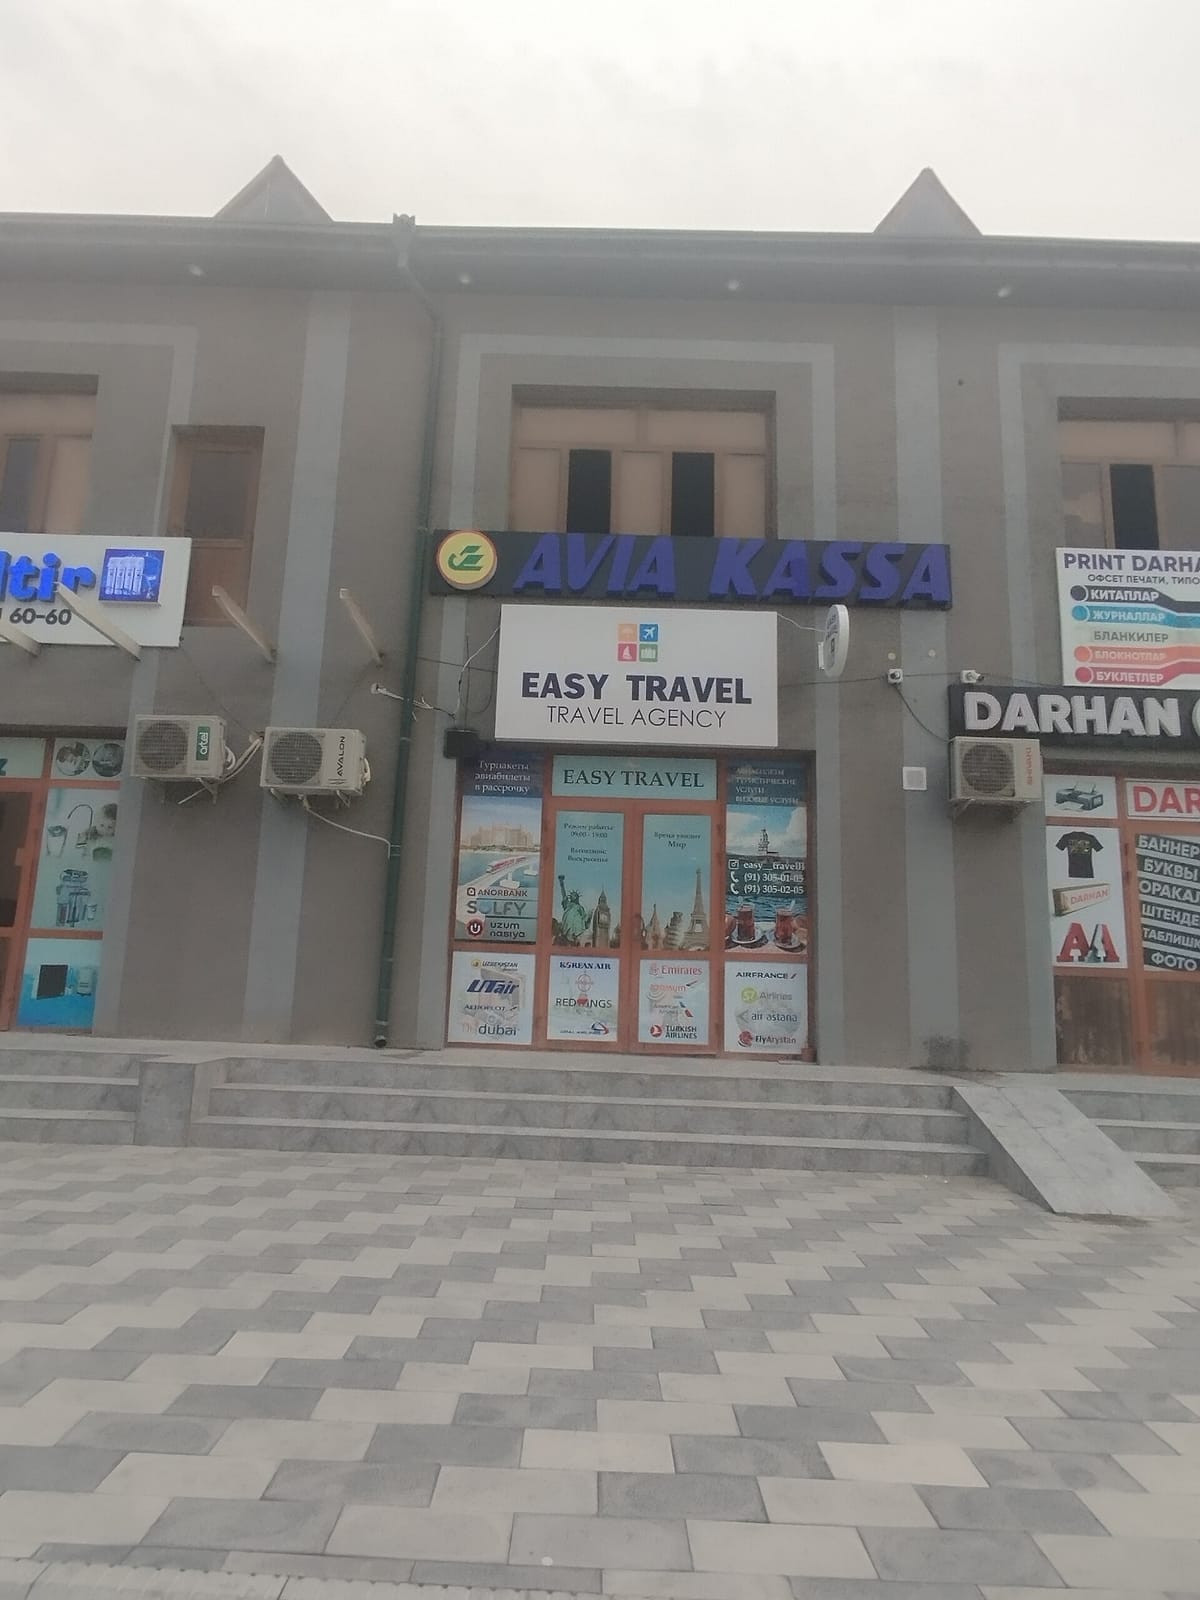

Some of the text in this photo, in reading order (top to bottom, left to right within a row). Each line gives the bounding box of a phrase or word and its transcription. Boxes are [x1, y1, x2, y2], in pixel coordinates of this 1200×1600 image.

[1063, 553, 1125, 570] PRINT
[512, 533, 950, 603] AVIA KASSA
[1088, 574, 1123, 583] ОФСЕТ
[1090, 589, 1160, 602] КИТАПЛАР
[1093, 610, 1165, 621] ЖУРНАЛЛАР
[1094, 631, 1169, 642] БЛАНКИЛЕР
[1095, 650, 1166, 661] БЛОКНОТЛАР
[1096, 672, 1164, 683] БУКЛЕТЛЕР
[521, 672, 752, 704] EASY TRAVEL
[547, 706, 726, 728] TRAVEL AGENCY
[963, 691, 1182, 737] DARHAN
[199, 732, 209, 755] artel
[336, 736, 346, 777] AVALON
[563, 769, 704, 788] EASY TRAVEL
[482, 784, 530, 795] рассрочку
[1143, 858, 1198, 881] БУКВЫ
[743, 872, 761, 882] (91)
[478, 889, 528, 897] ANORBANK
[743, 884, 804, 894] (91) 305-02-05
[490, 921, 520, 930] uzum
[490, 930, 526, 939] nasiya
[1151, 952, 1197, 972] ФОТО
[661, 965, 703, 976] Emirates
[467, 979, 519, 994] UTair
[751, 1012, 798, 1022] air astana
